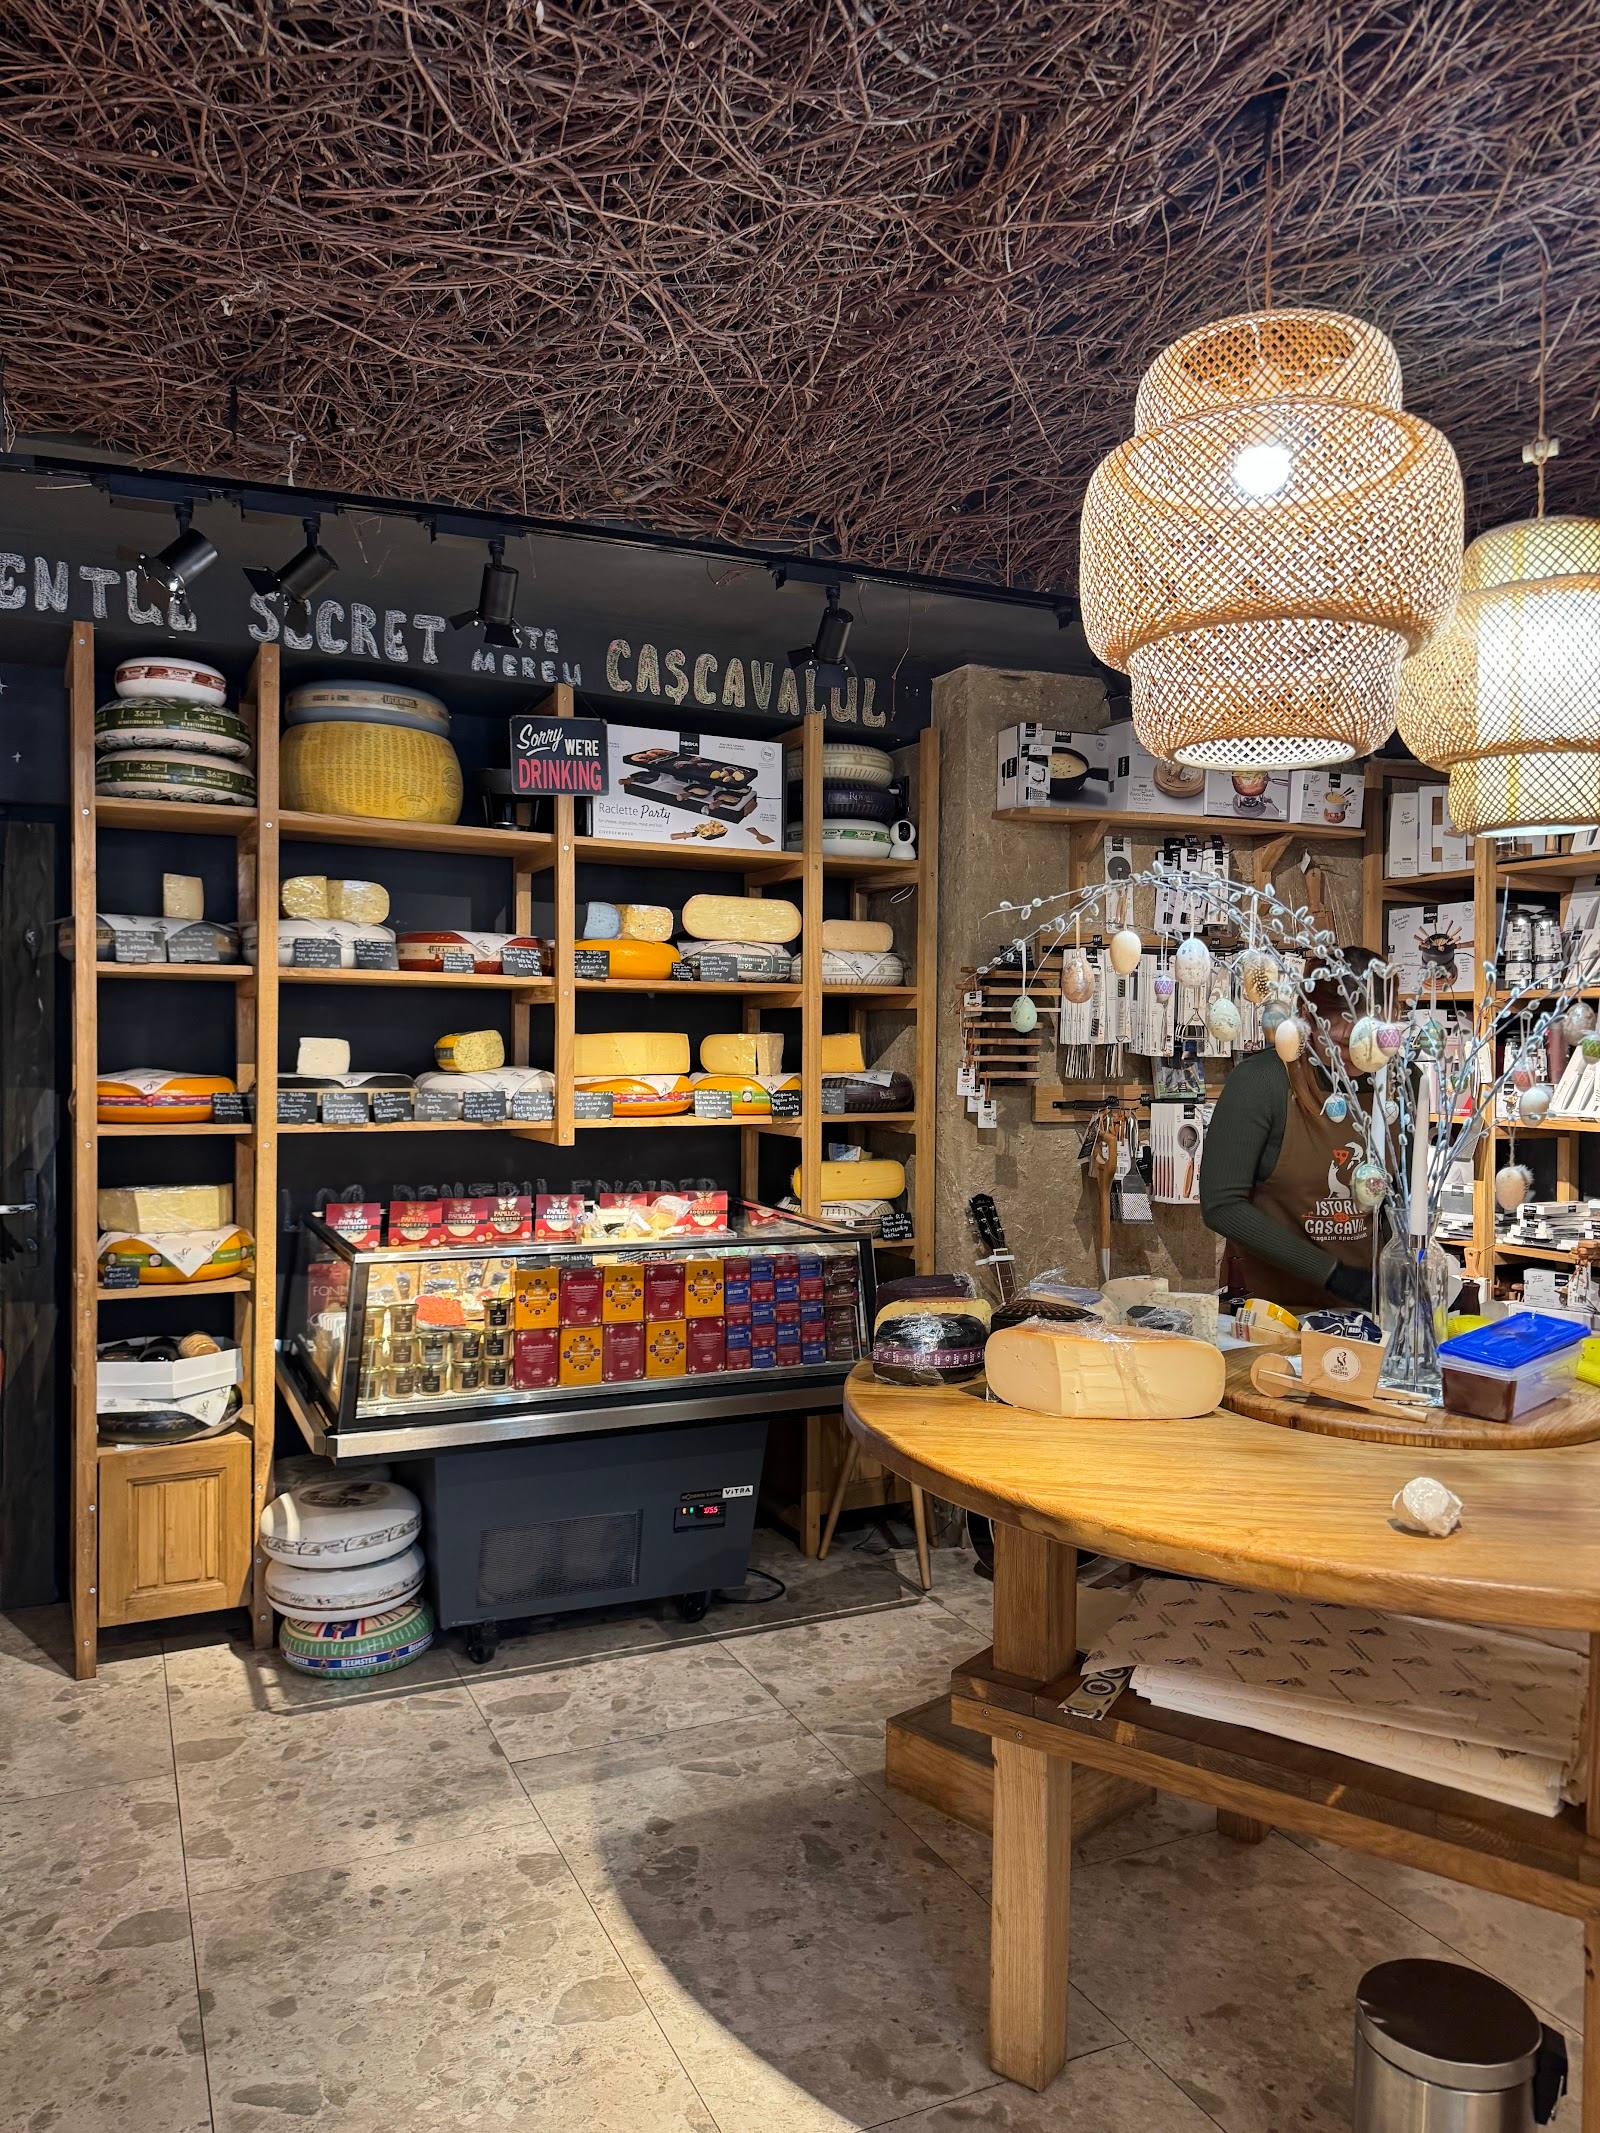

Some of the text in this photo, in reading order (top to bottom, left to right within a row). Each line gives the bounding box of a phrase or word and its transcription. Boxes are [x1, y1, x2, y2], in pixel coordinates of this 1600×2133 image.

[471, 648, 582, 686] MEREU
[516, 723, 599, 756] Sorry WE'RE
[518, 758, 602, 791] DRINKING
[599, 803, 671, 824] Raclette Party
[1315, 1200, 1364, 1216] ISTORI
[340, 1656, 378, 1668] BEEMSTER
